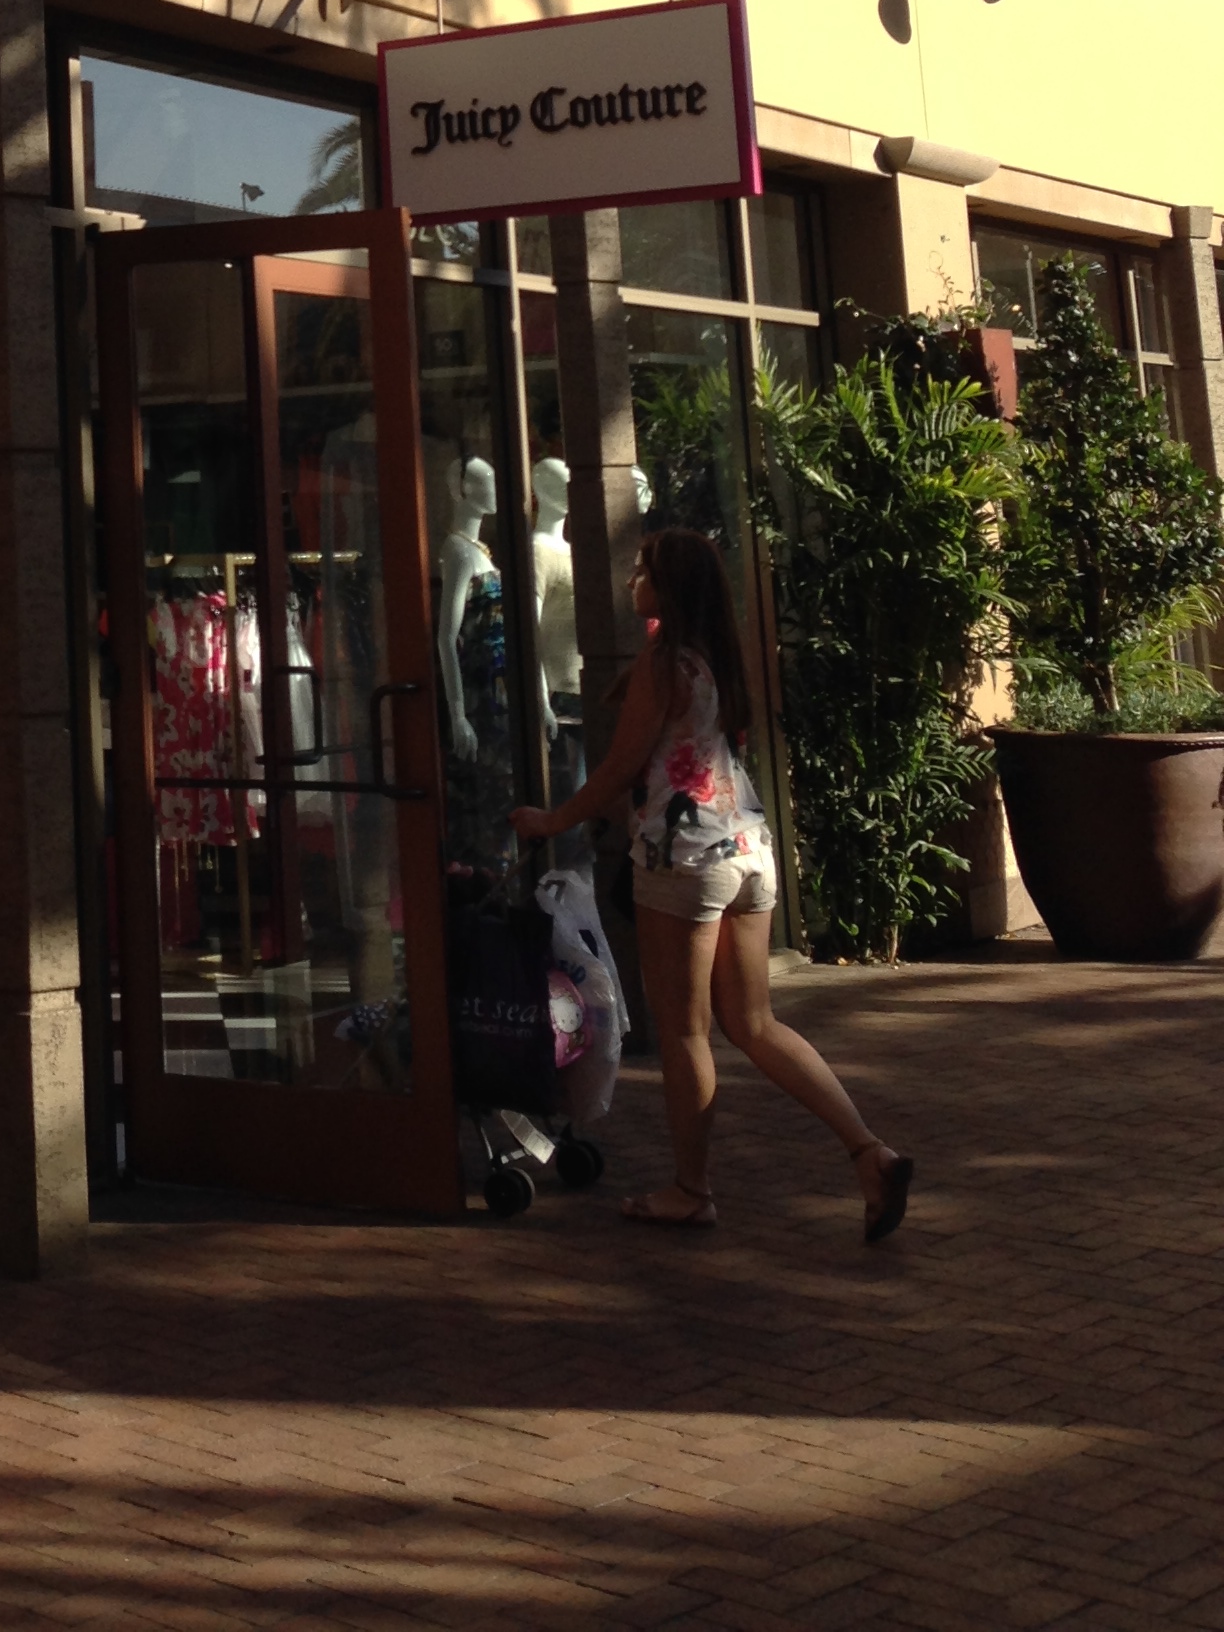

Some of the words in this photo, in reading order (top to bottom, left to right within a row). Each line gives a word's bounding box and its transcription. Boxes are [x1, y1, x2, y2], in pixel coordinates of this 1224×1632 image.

[410, 98, 521, 156] Juicy
[530, 81, 707, 134] Couture
[491, 1000, 543, 1023] sea
